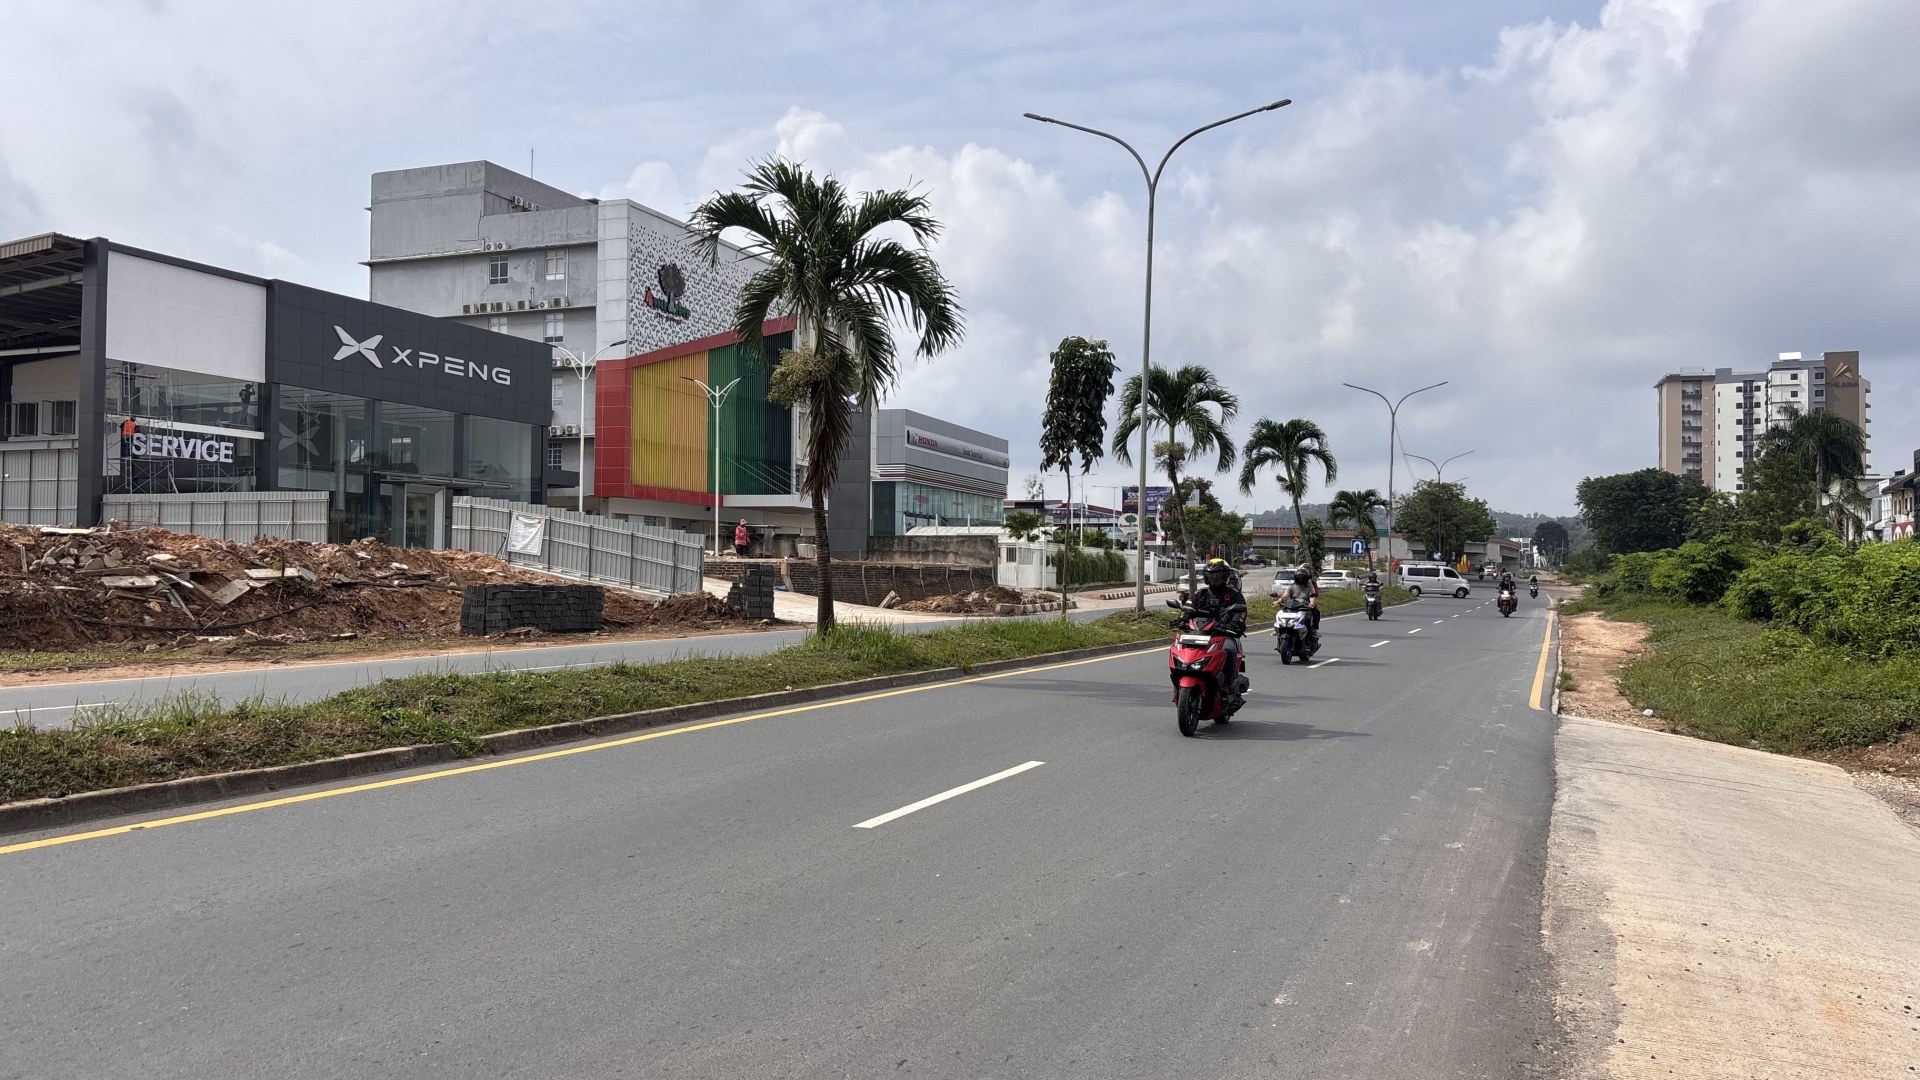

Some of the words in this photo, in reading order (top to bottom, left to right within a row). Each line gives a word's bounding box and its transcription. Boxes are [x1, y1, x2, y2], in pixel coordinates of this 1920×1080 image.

[391, 345, 511, 386] XPENG
[131, 432, 234, 463] SERVICE
[918, 435, 938, 448] HONDA
